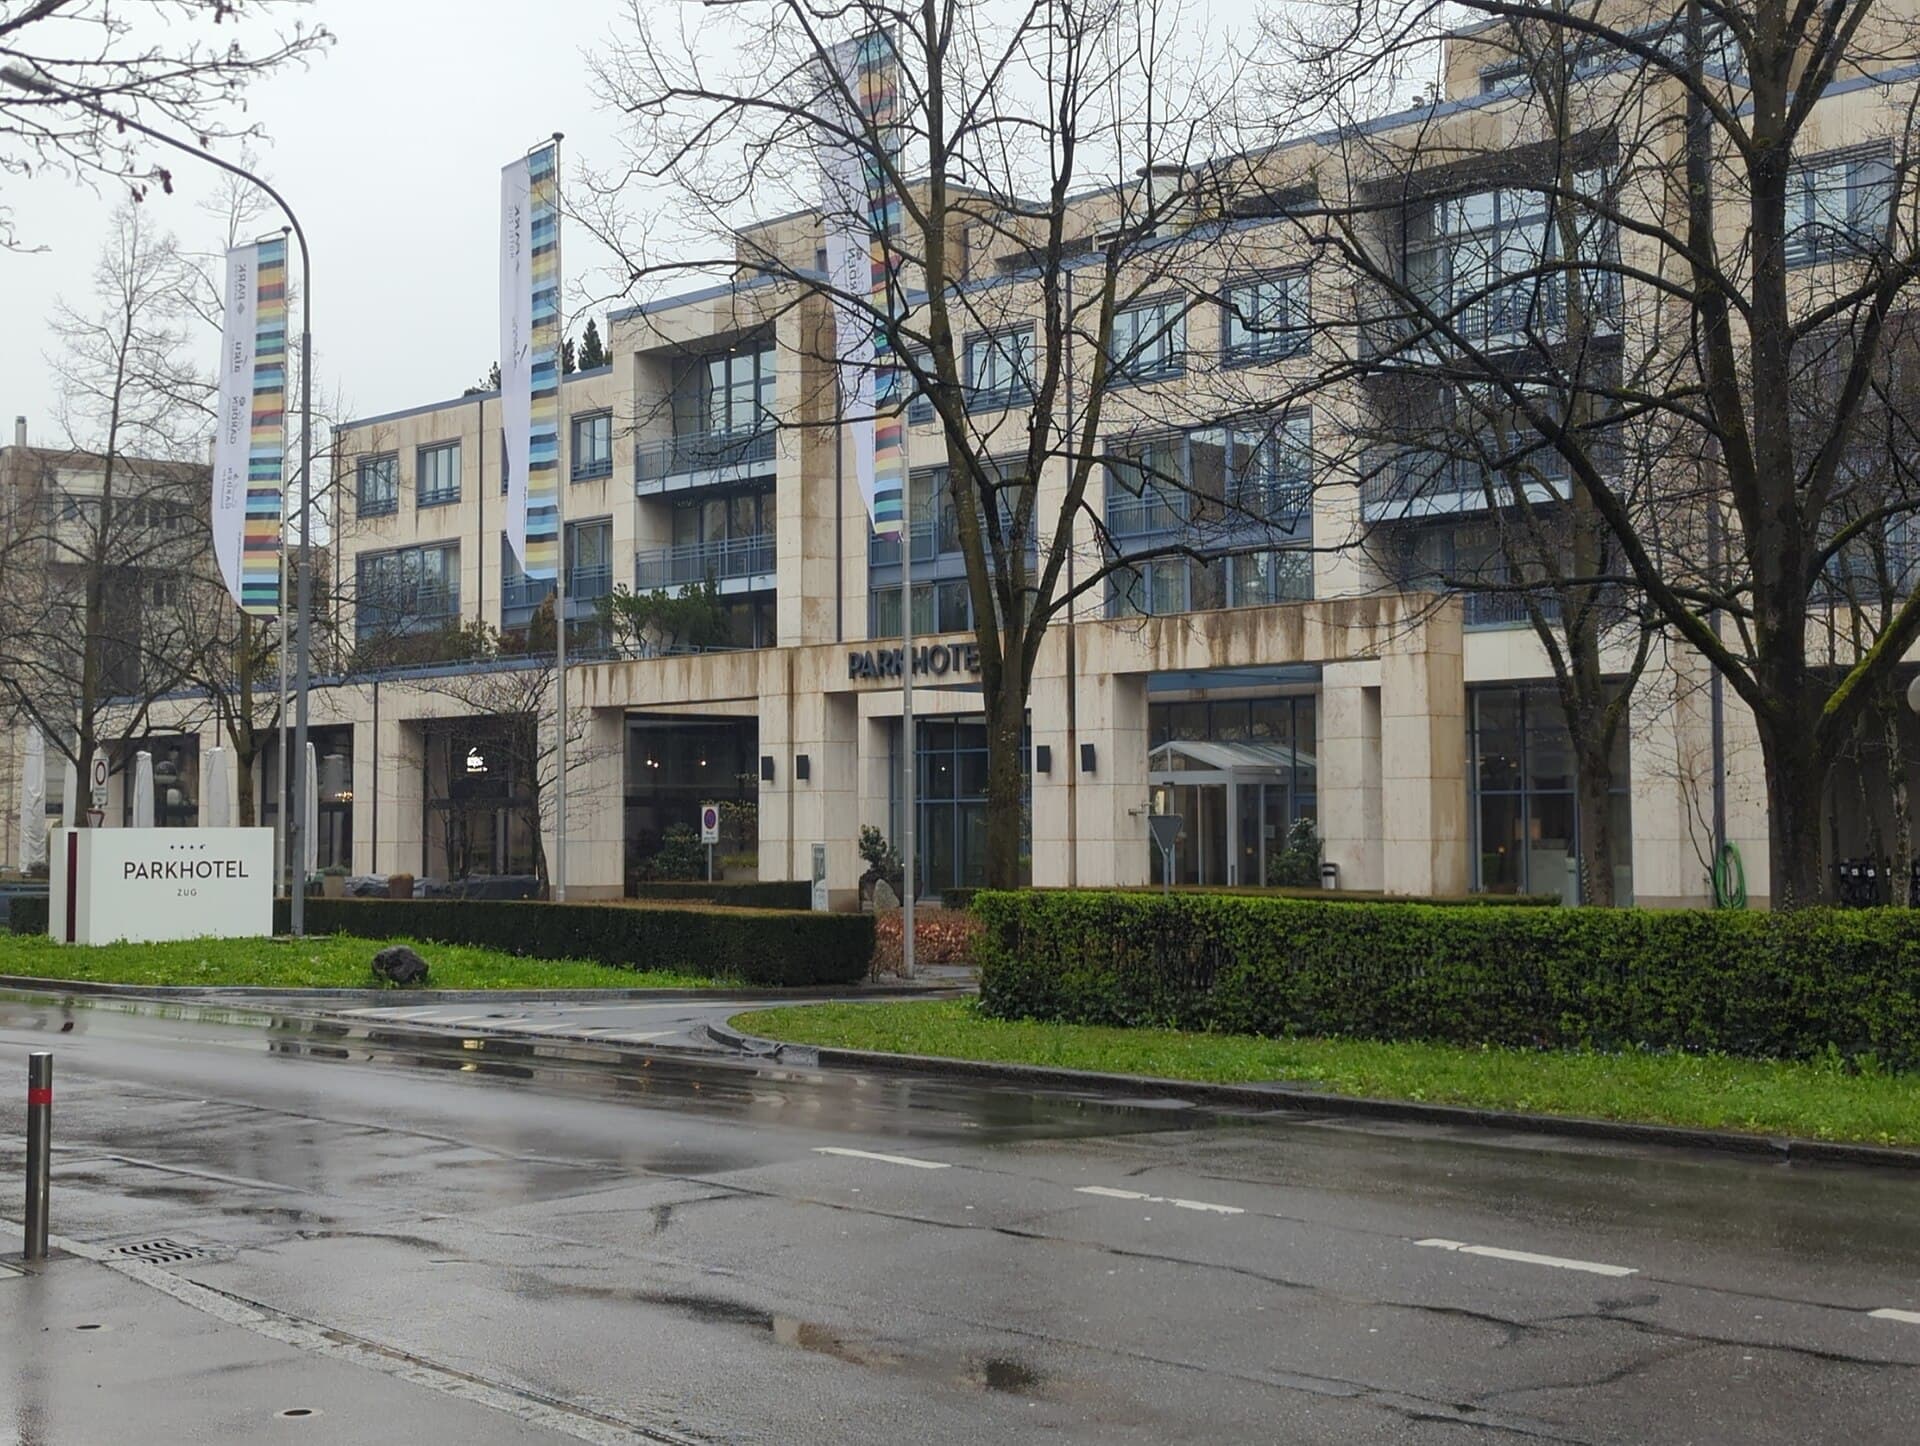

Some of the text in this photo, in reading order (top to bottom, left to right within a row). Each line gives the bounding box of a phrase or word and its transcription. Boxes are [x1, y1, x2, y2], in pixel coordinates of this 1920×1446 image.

[848, 642, 981, 680] PARKHOTE
[124, 860, 249, 880] PARKHOTEL
[177, 888, 198, 897] ZUG
